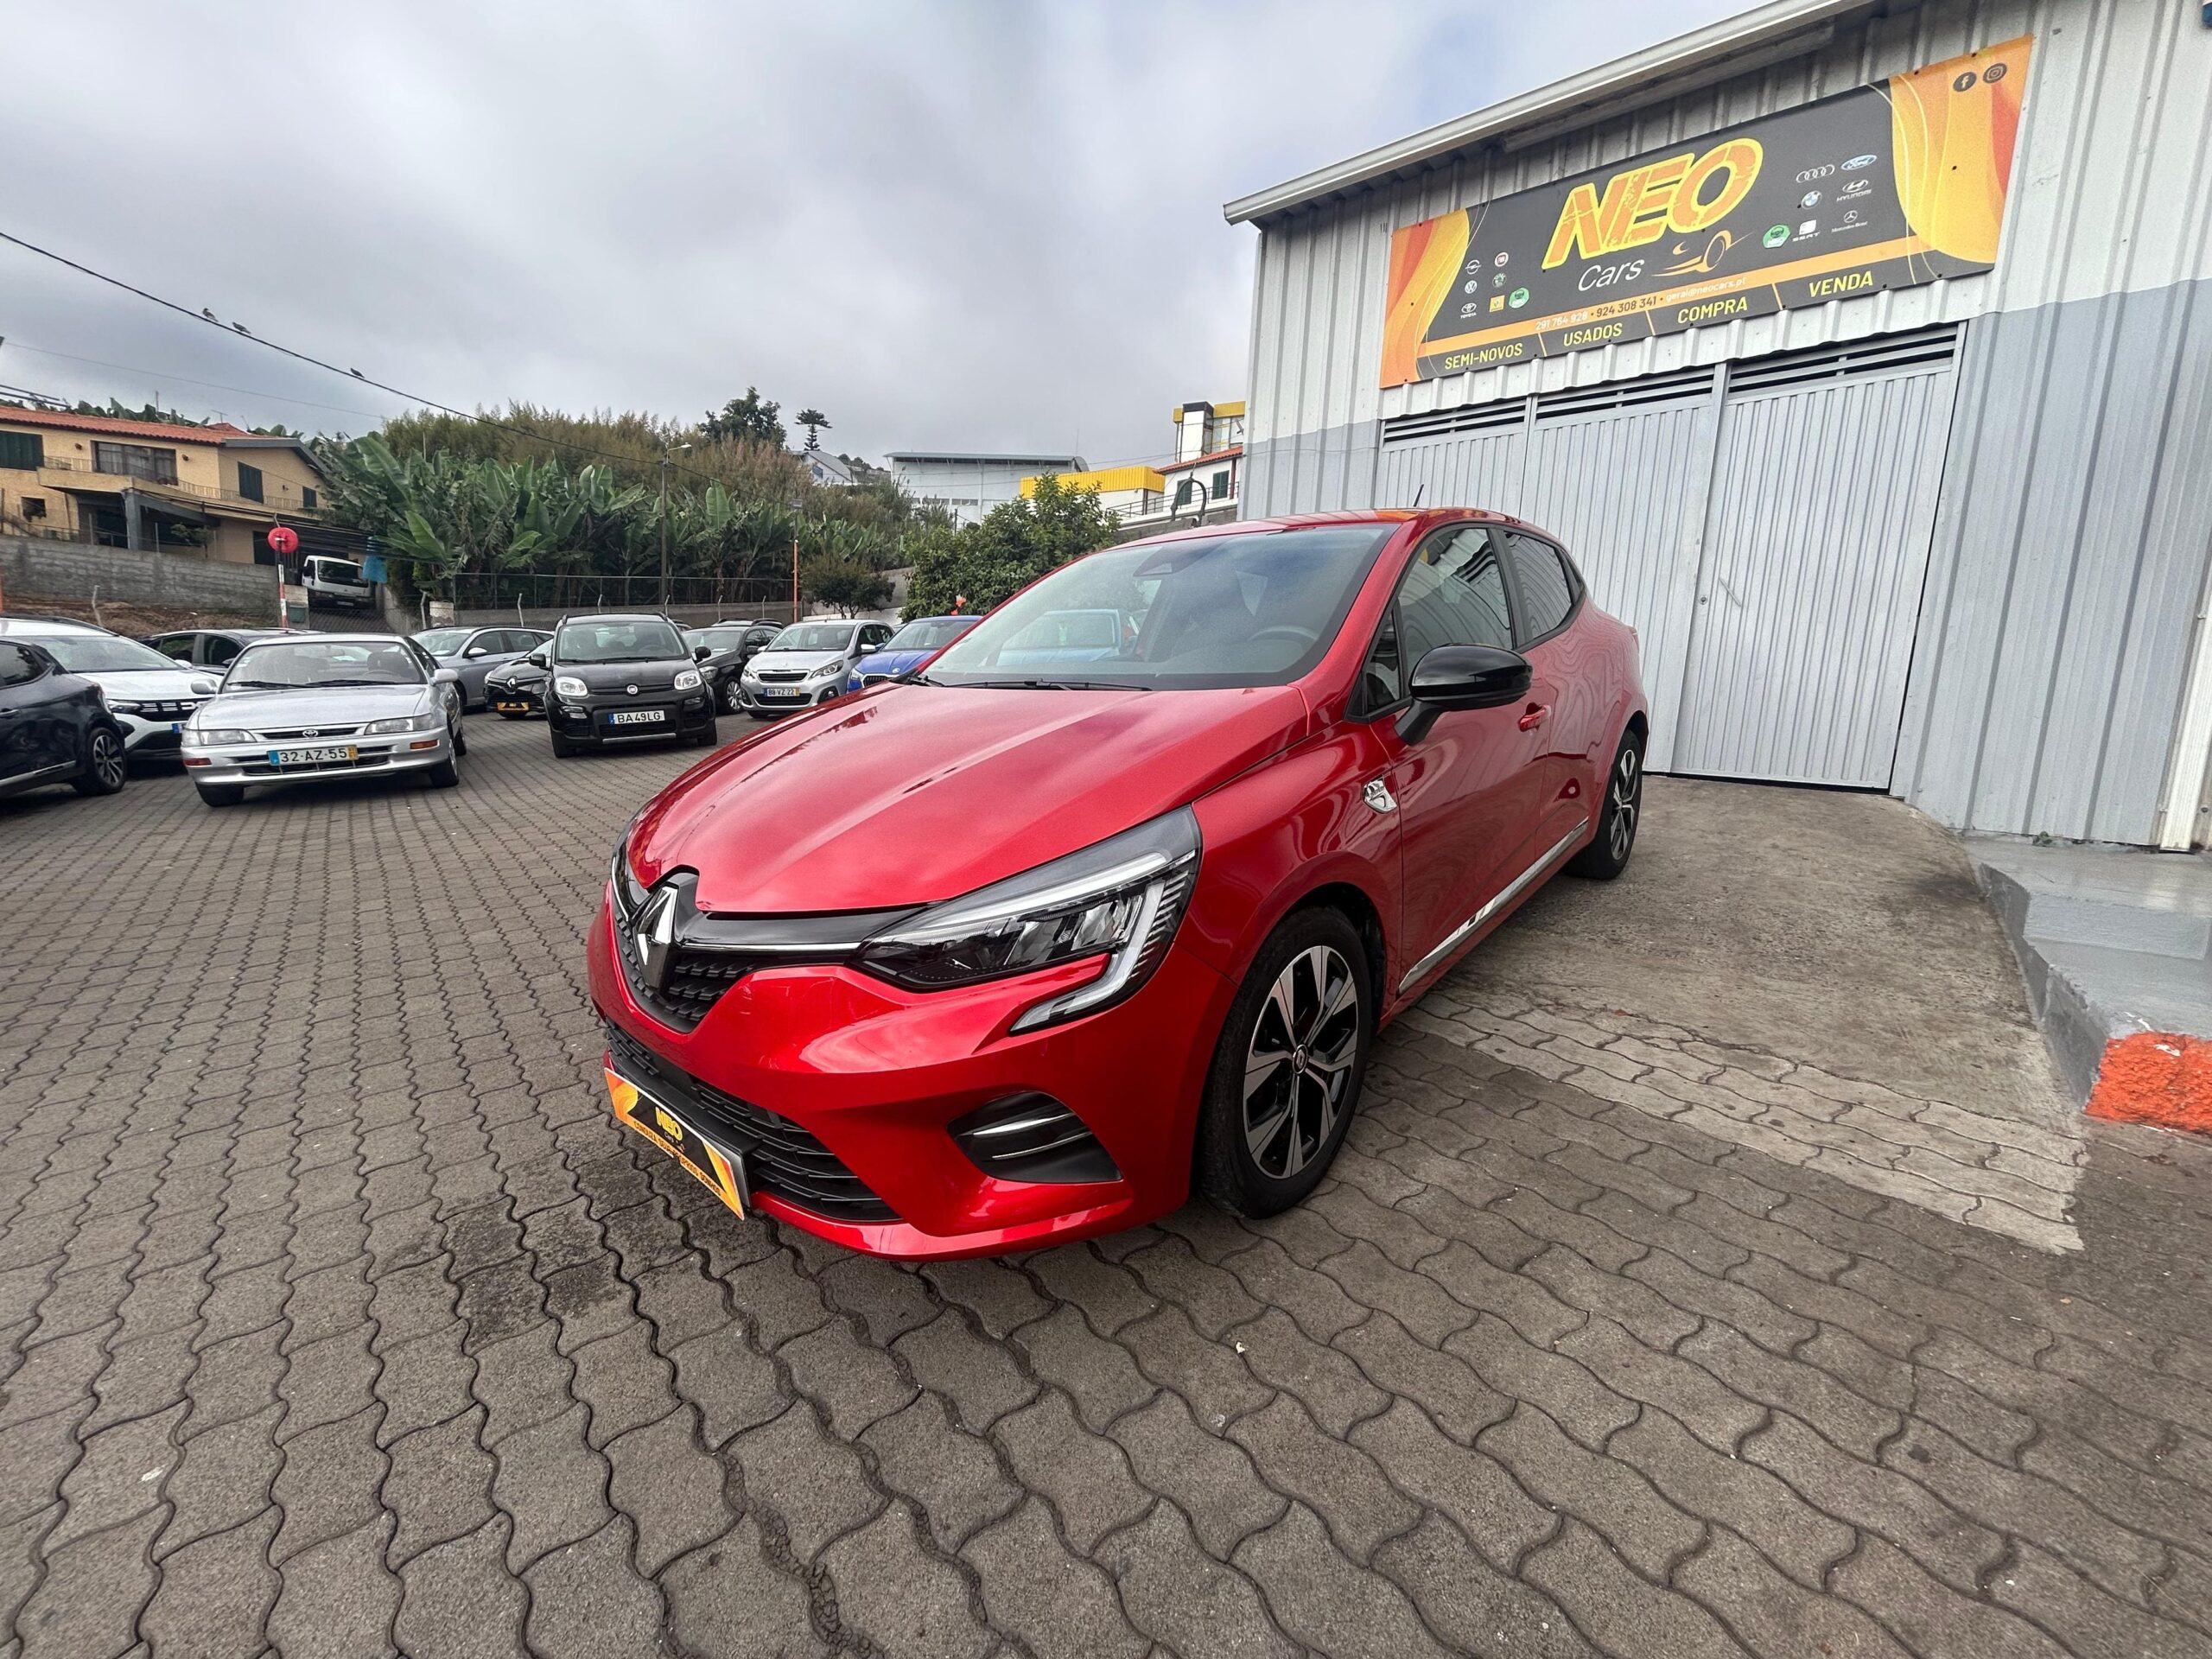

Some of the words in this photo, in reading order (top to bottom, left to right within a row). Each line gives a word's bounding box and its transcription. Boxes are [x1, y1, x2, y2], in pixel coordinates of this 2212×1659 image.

[1541, 138, 1764, 270] NEO
[1578, 259, 1645, 292] Cars
[1808, 270, 1873, 297] VENDA
[1535, 320, 1549, 331] 291
[1552, 316, 1568, 327] 764
[1571, 311, 1588, 323] 928
[1597, 306, 1615, 317] 924
[1618, 301, 1637, 313] 308
[1639, 296, 1656, 308] 341
[1666, 277, 1747, 302] geral@neocars.pt
[1677, 296, 1748, 324] COMPRA
[1563, 322, 1623, 346] USADOS
[1444, 343, 1523, 370] SEMI-NOVOS
[655, 1106, 683, 1141] NEO
